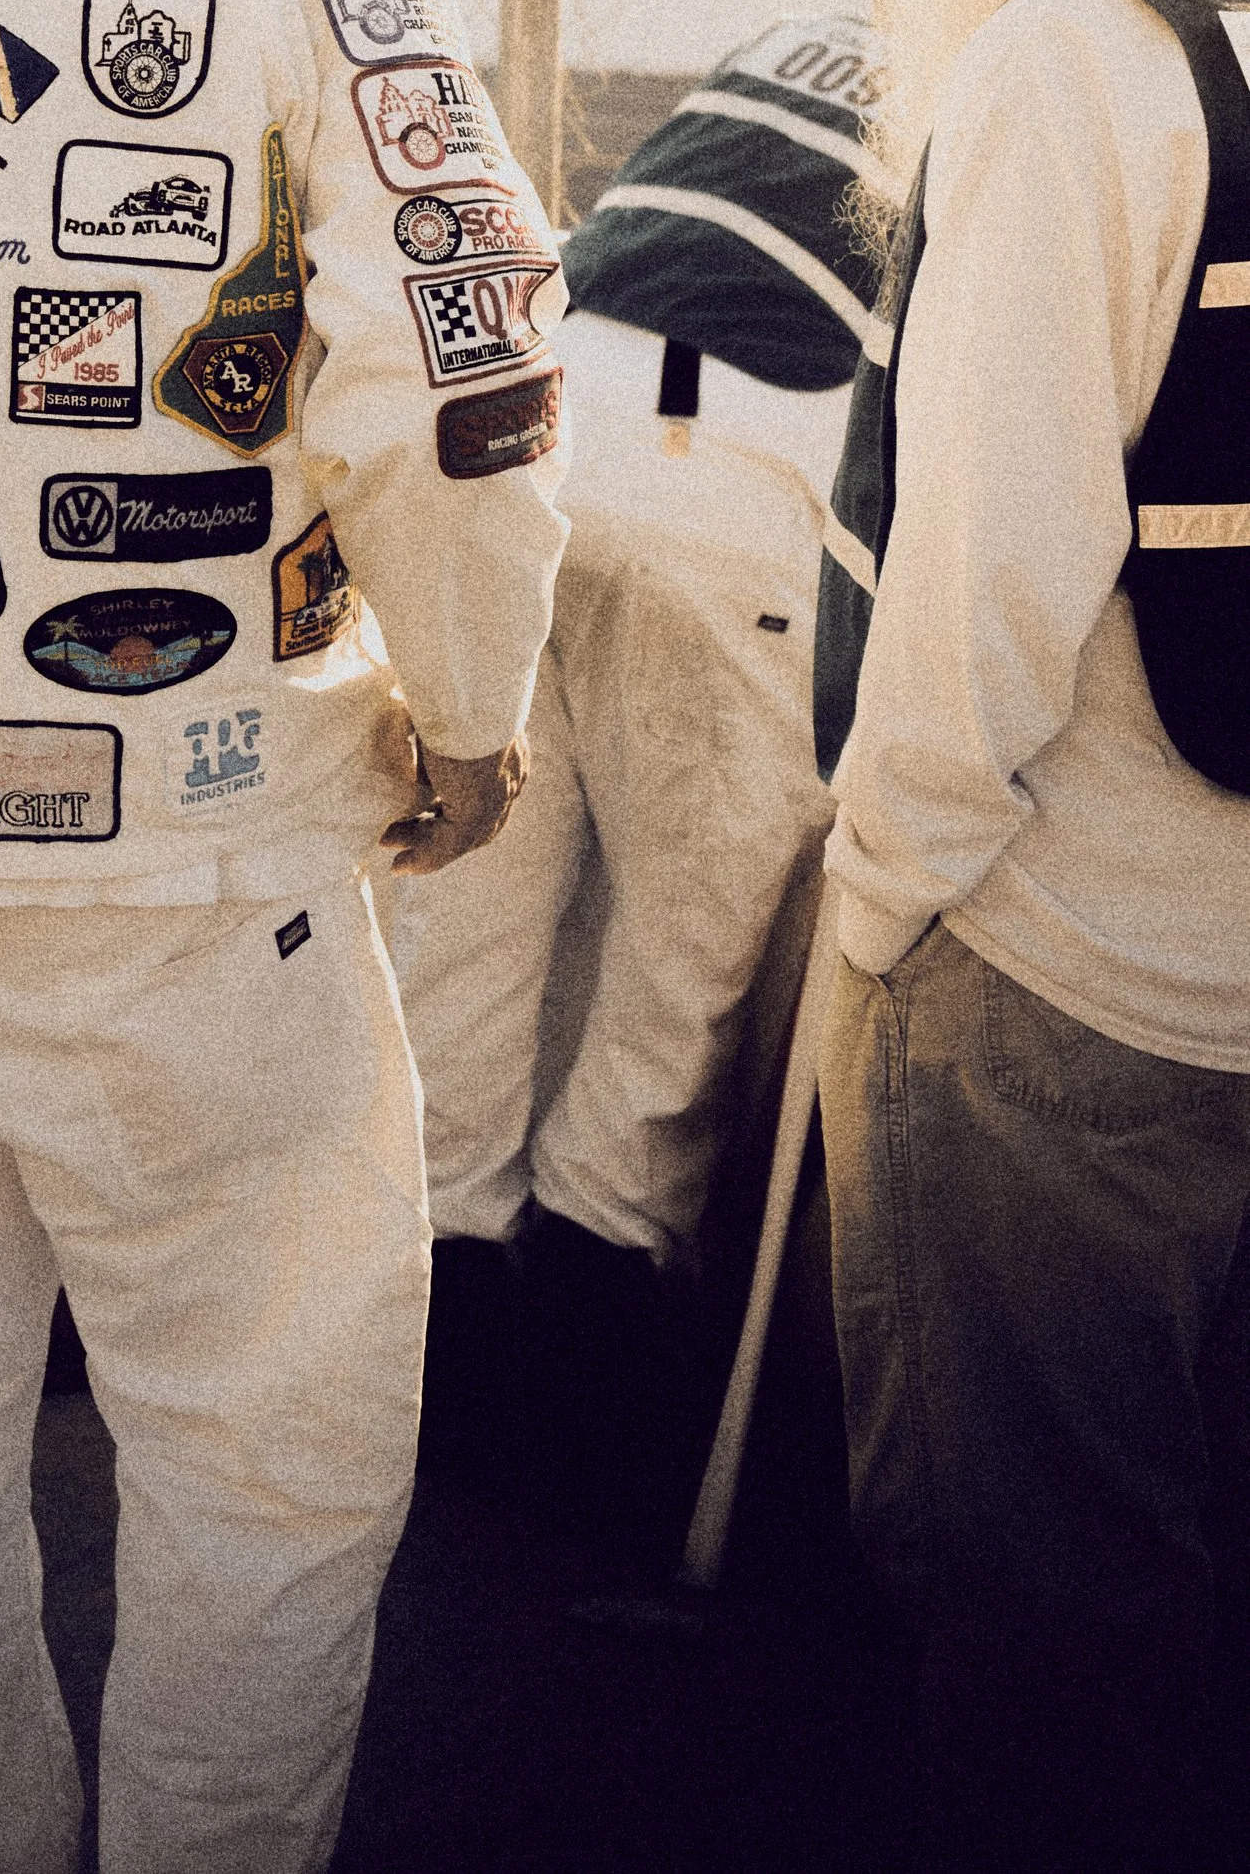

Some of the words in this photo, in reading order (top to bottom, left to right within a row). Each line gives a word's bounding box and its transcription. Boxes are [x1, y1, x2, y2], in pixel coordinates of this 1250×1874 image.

[113, 44, 138, 79] SPORTS
[139, 43, 162, 57] CAR
[162, 54, 176, 82] CLUB
[118, 85, 131, 100] OF
[131, 84, 173, 108] AMERICA
[270, 138, 290, 278] NATIONAL
[398, 206, 417, 240] SPORTS
[416, 201, 436, 213] CAR
[438, 207, 456, 233] CLUB
[64, 218, 126, 235] ROAD
[132, 219, 217, 246] ATLANTA
[472, 234, 504, 251] PRO
[406, 244, 418, 259] OF
[418, 237, 456, 260] AMERICA
[221, 290, 296, 317] RACES
[87, 324, 103, 348] the
[106, 303, 135, 336] Point
[442, 339, 514, 368] INTERNATIONAL
[74, 361, 119, 383] 1985
[46, 393, 87, 407] SEARS
[91, 396, 130, 408] POINT
[119, 497, 257, 537] Motorsport
[90, 598, 174, 615] SHIRLEY
[180, 771, 266, 806] INDUSTRIES
